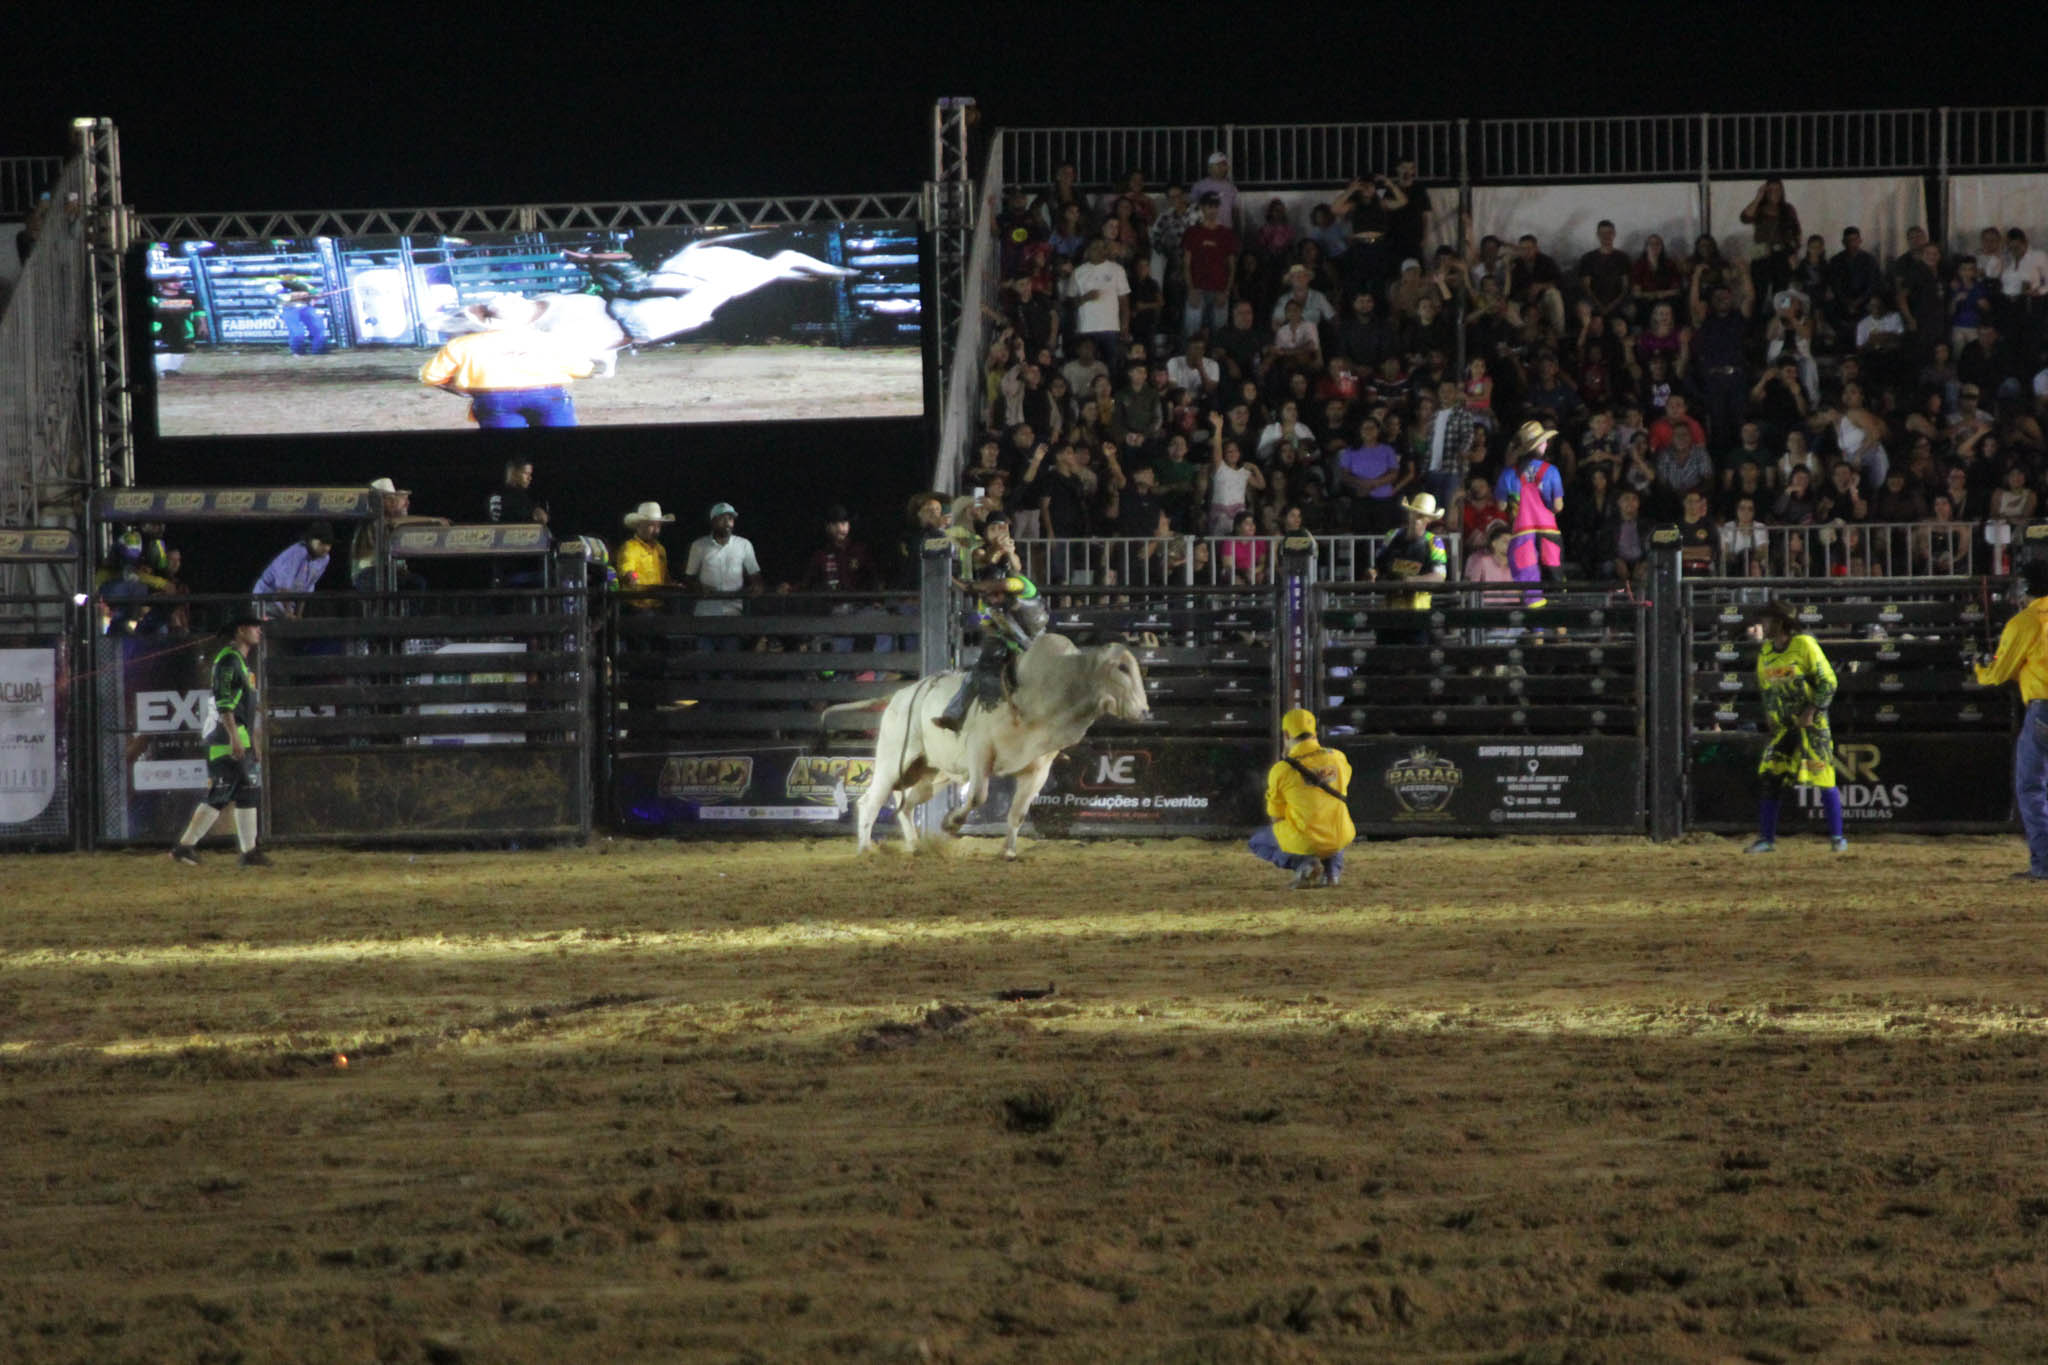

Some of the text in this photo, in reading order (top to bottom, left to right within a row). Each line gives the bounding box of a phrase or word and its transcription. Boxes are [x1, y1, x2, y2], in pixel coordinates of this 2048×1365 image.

[1479, 744, 1583, 757] SHOPPING DO CAMINHÃO
[1064, 793, 1139, 811] Produções
[1142, 798, 1150, 808] e
[1154, 795, 1209, 808] Eventos
